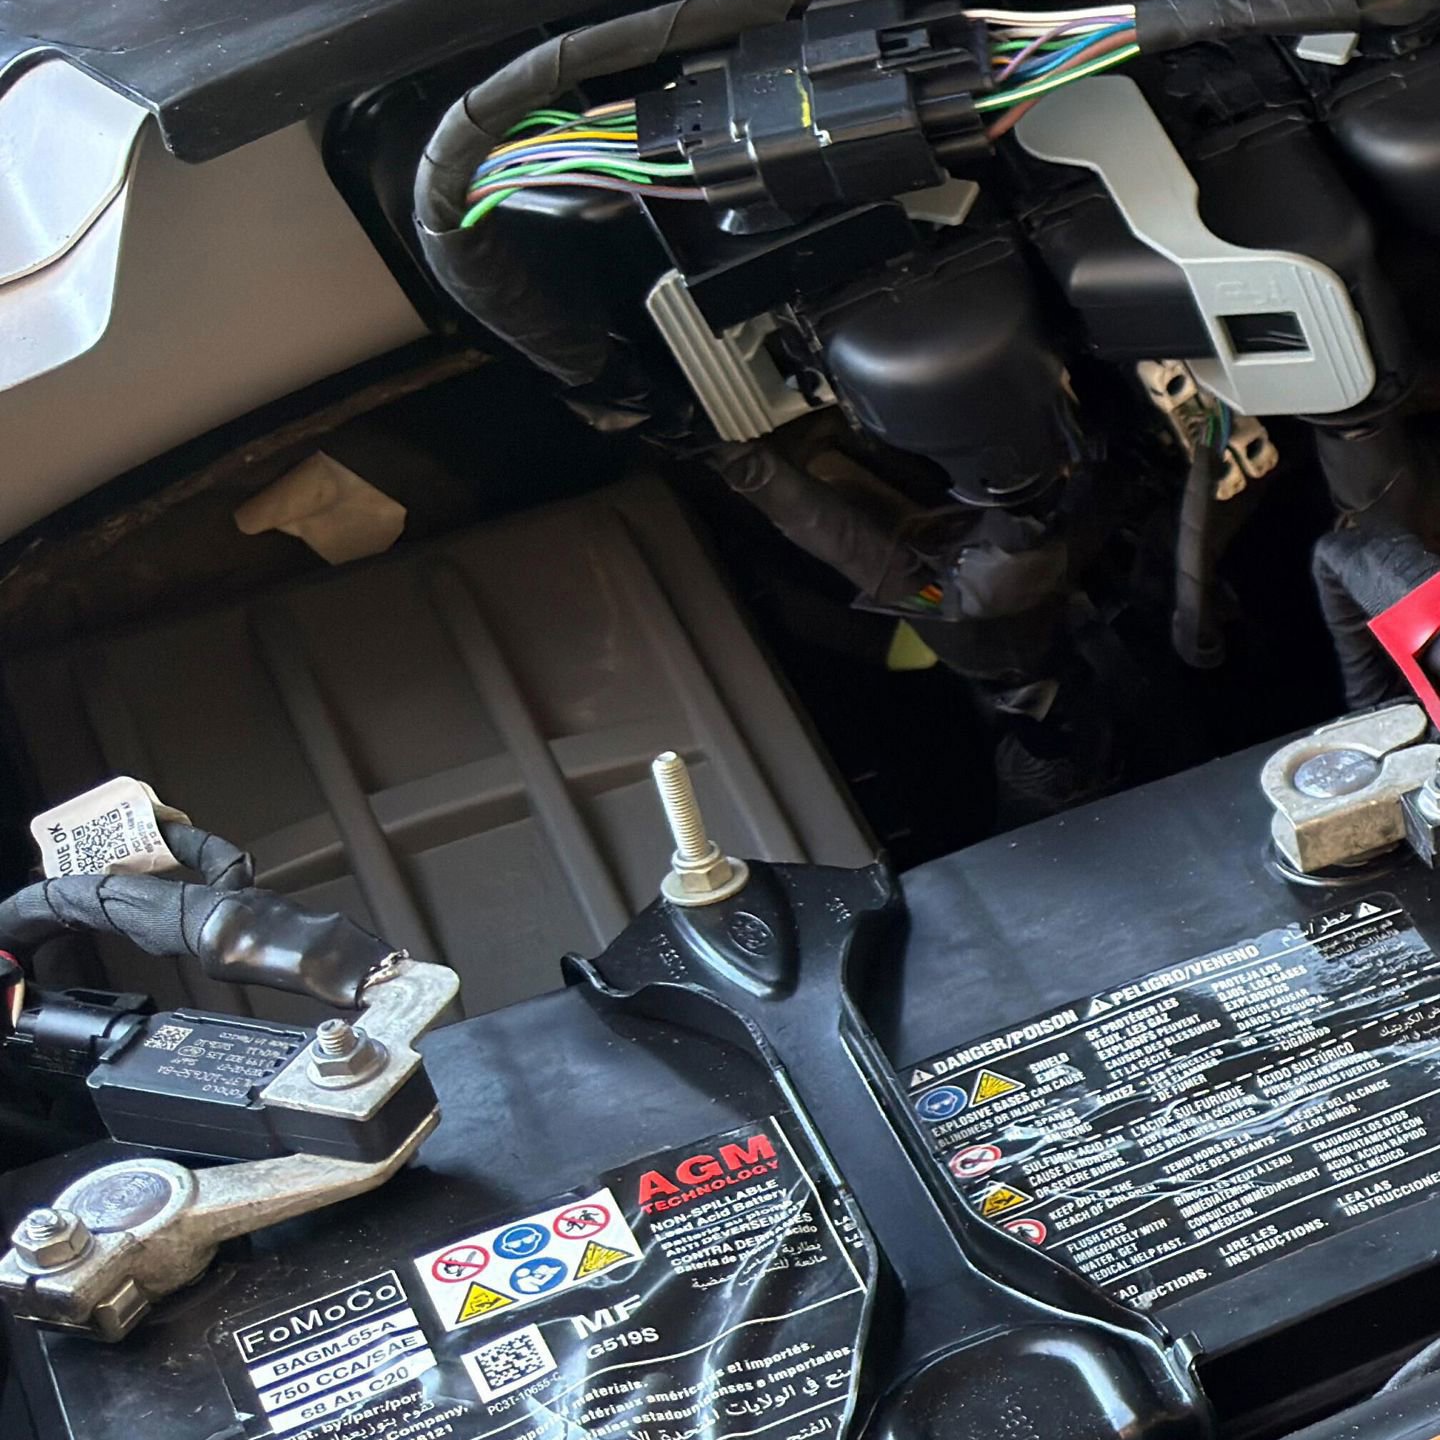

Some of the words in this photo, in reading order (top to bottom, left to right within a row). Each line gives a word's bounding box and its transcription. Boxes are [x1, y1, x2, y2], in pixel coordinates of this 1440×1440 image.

[47, 823, 65, 842] OK
[1108, 939, 1261, 1007] PELIGRO/VENENO
[931, 1008, 1088, 1077] DANGER/POISON
[1248, 1061, 1293, 1090] ÁCIDO
[1283, 1040, 1362, 1076] SULFÚRICO
[635, 1133, 778, 1210] AGM
[641, 1152, 782, 1222] TECHNOLOGY
[1335, 1189, 1367, 1209] LEA
[1362, 1179, 1393, 1198] LAS
[649, 1173, 779, 1237] NON-SPILLABLE
[694, 1205, 733, 1229] Acid
[732, 1184, 789, 1216] Battery
[1217, 1234, 1253, 1258] LIRE
[1249, 1223, 1286, 1246] LES
[1220, 1217, 1330, 1268] INSTRUCTIONS.
[242, 1280, 401, 1354] FoMoCo
[570, 1290, 648, 1341] MF
[268, 1381, 311, 1406] 750
[314, 1335, 426, 1387] CCA/SAE
[271, 1320, 405, 1378] BAGM-65-A
[583, 1326, 661, 1361] G519S
